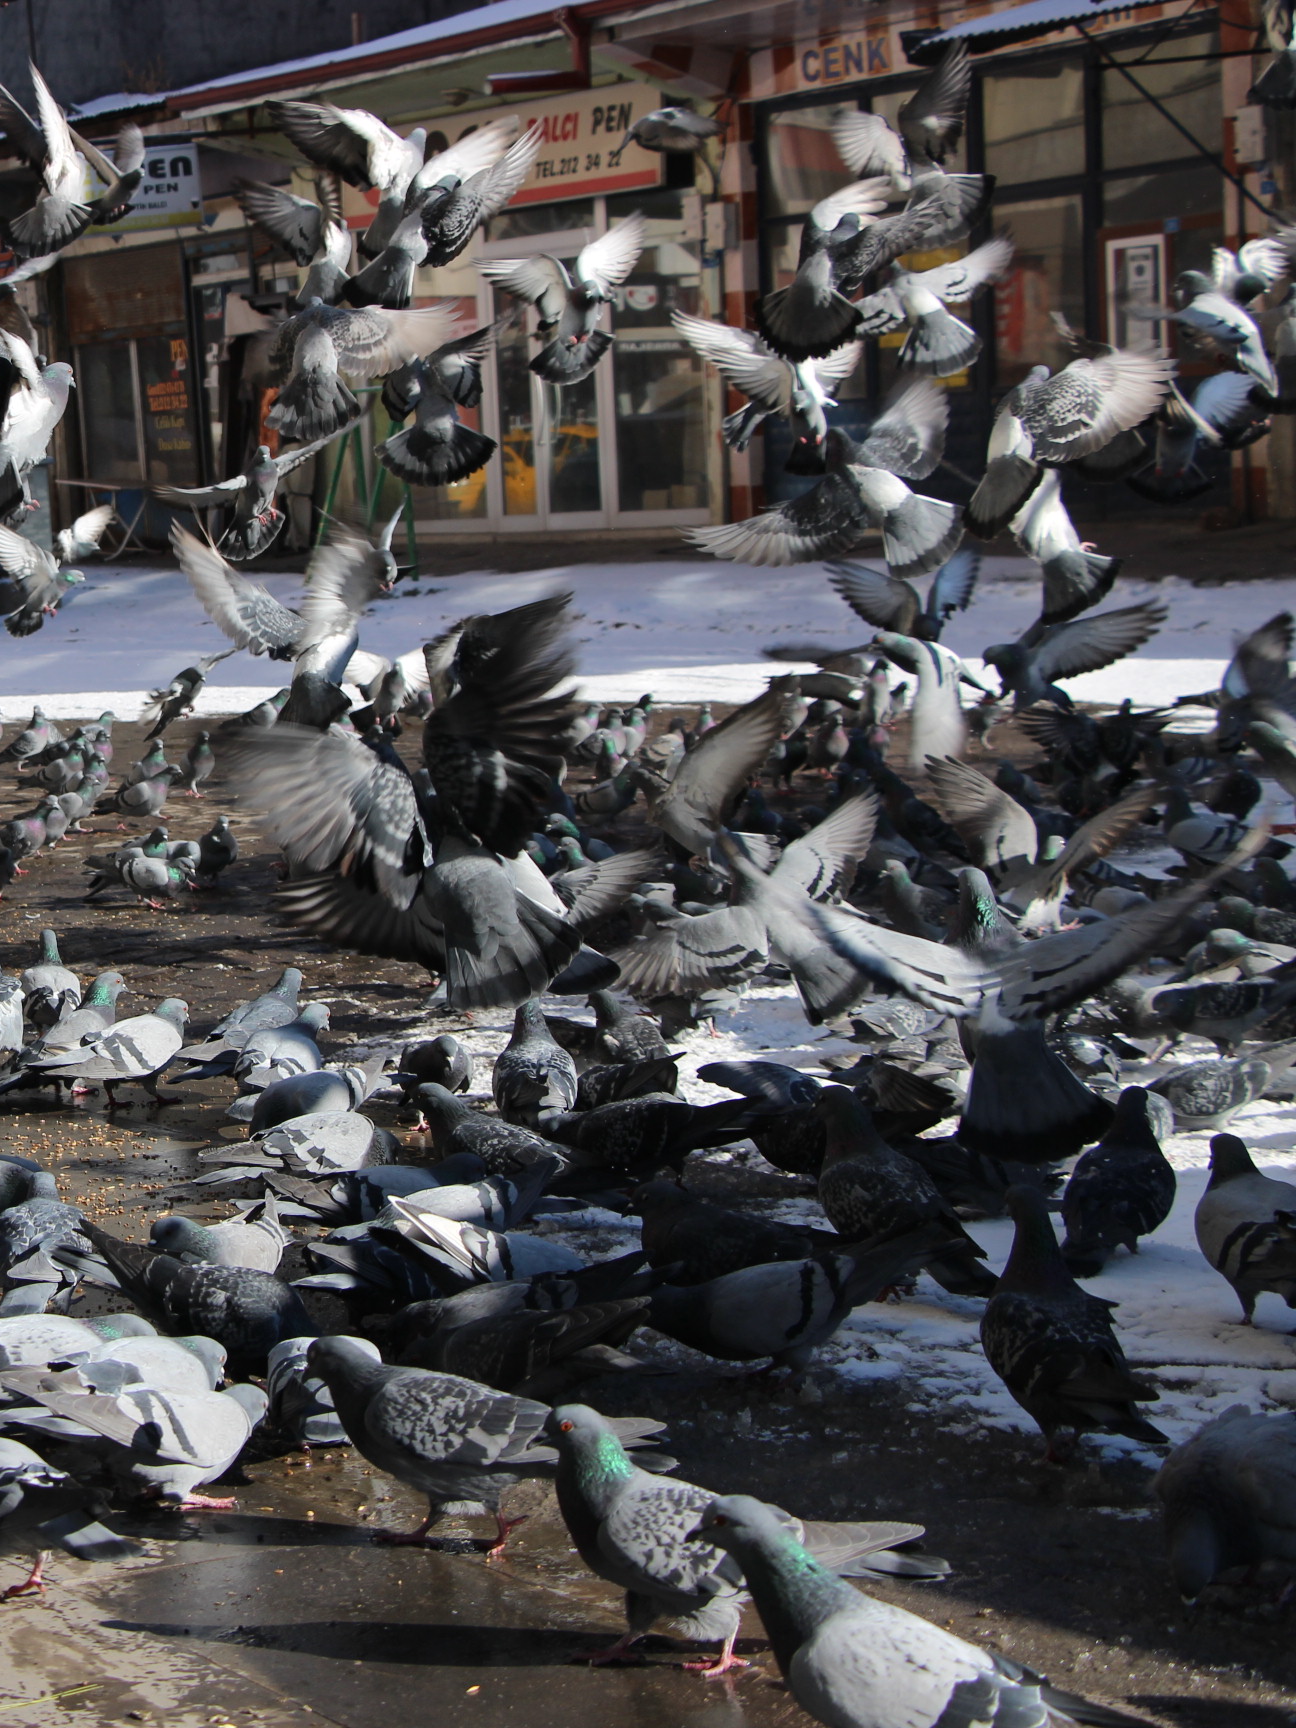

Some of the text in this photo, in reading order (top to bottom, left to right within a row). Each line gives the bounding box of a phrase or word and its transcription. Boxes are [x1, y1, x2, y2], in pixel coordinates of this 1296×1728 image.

[801, 37, 891, 83] CENK
[591, 102, 633, 135] PEN
[585, 151, 601, 171] 34
[144, 182, 179, 195] PEN
